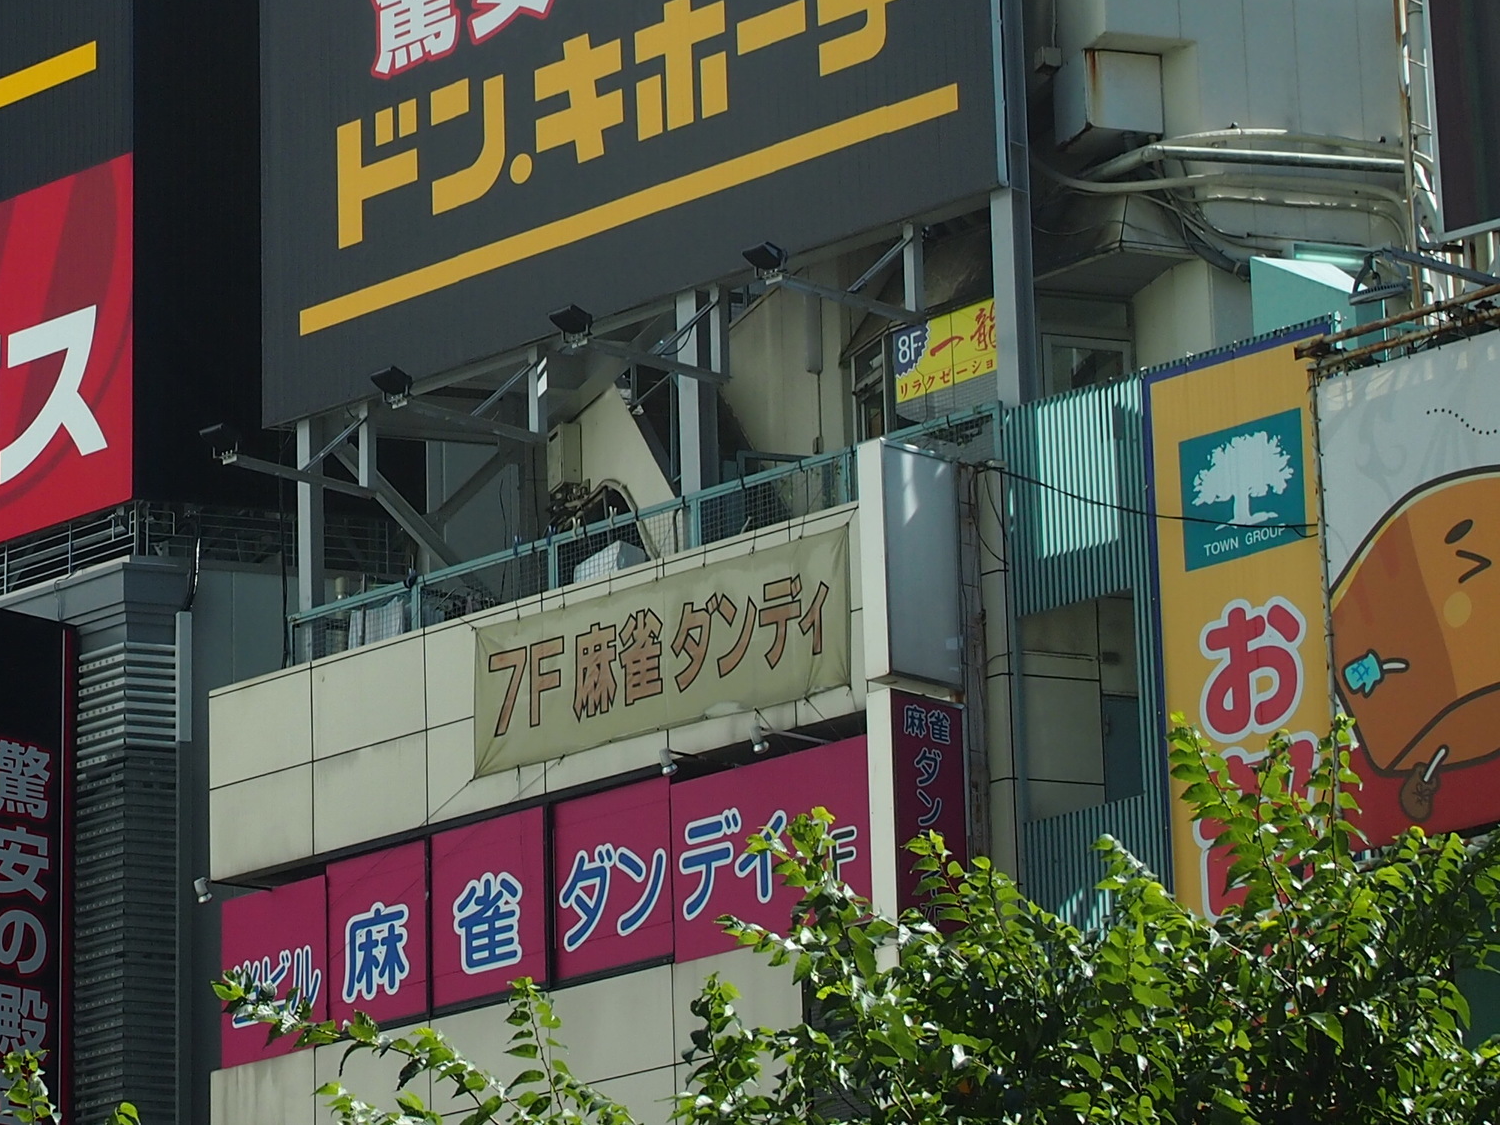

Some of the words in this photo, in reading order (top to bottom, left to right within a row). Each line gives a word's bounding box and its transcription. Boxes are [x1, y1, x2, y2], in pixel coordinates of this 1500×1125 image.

[897, 330, 922, 364] 8F
[1203, 536, 1239, 557] TOWN
[1245, 523, 1286, 545] GROUP
[904, 704, 950, 745] 麻雀
